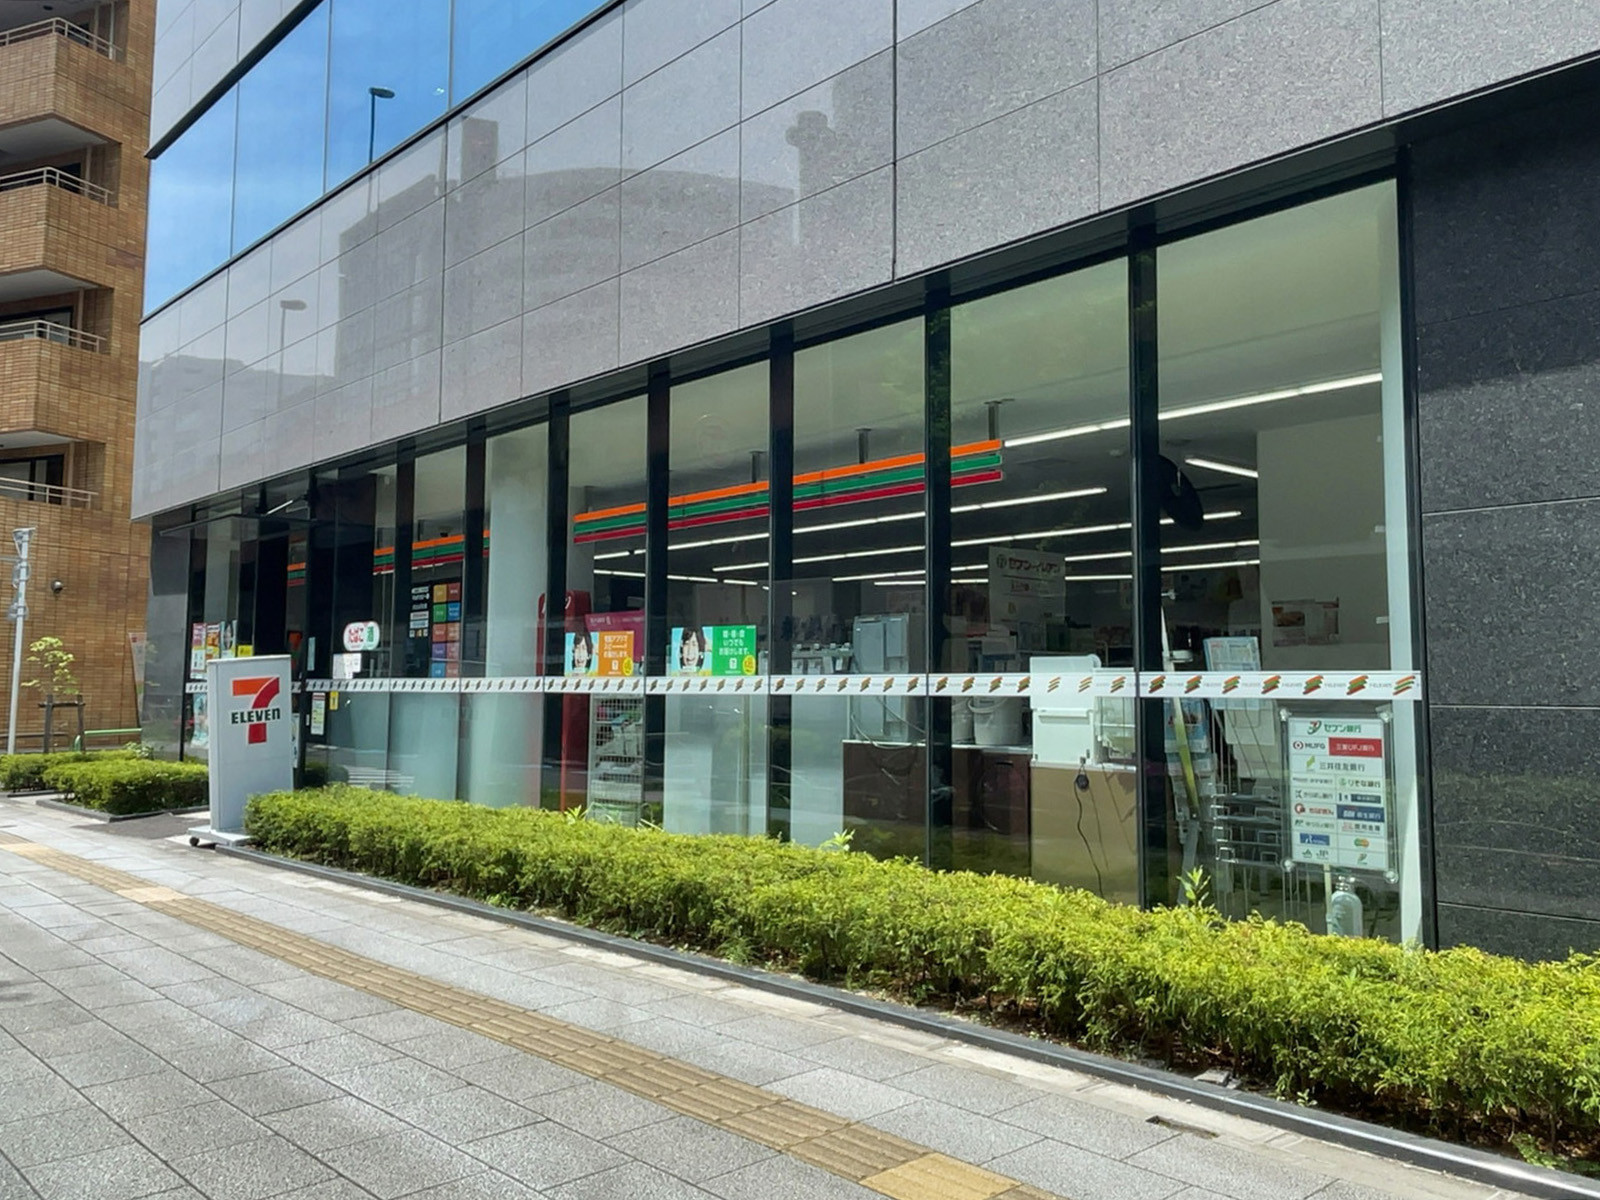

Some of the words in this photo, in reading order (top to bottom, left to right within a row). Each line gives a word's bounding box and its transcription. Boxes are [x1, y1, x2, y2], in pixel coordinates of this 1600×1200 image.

[232, 676, 280, 744] 7
[1324, 724, 1362, 733] セブン銀行
[1320, 762, 1365, 772] 三井住友銀行
[1348, 779, 1381, 788] りそな銀行
